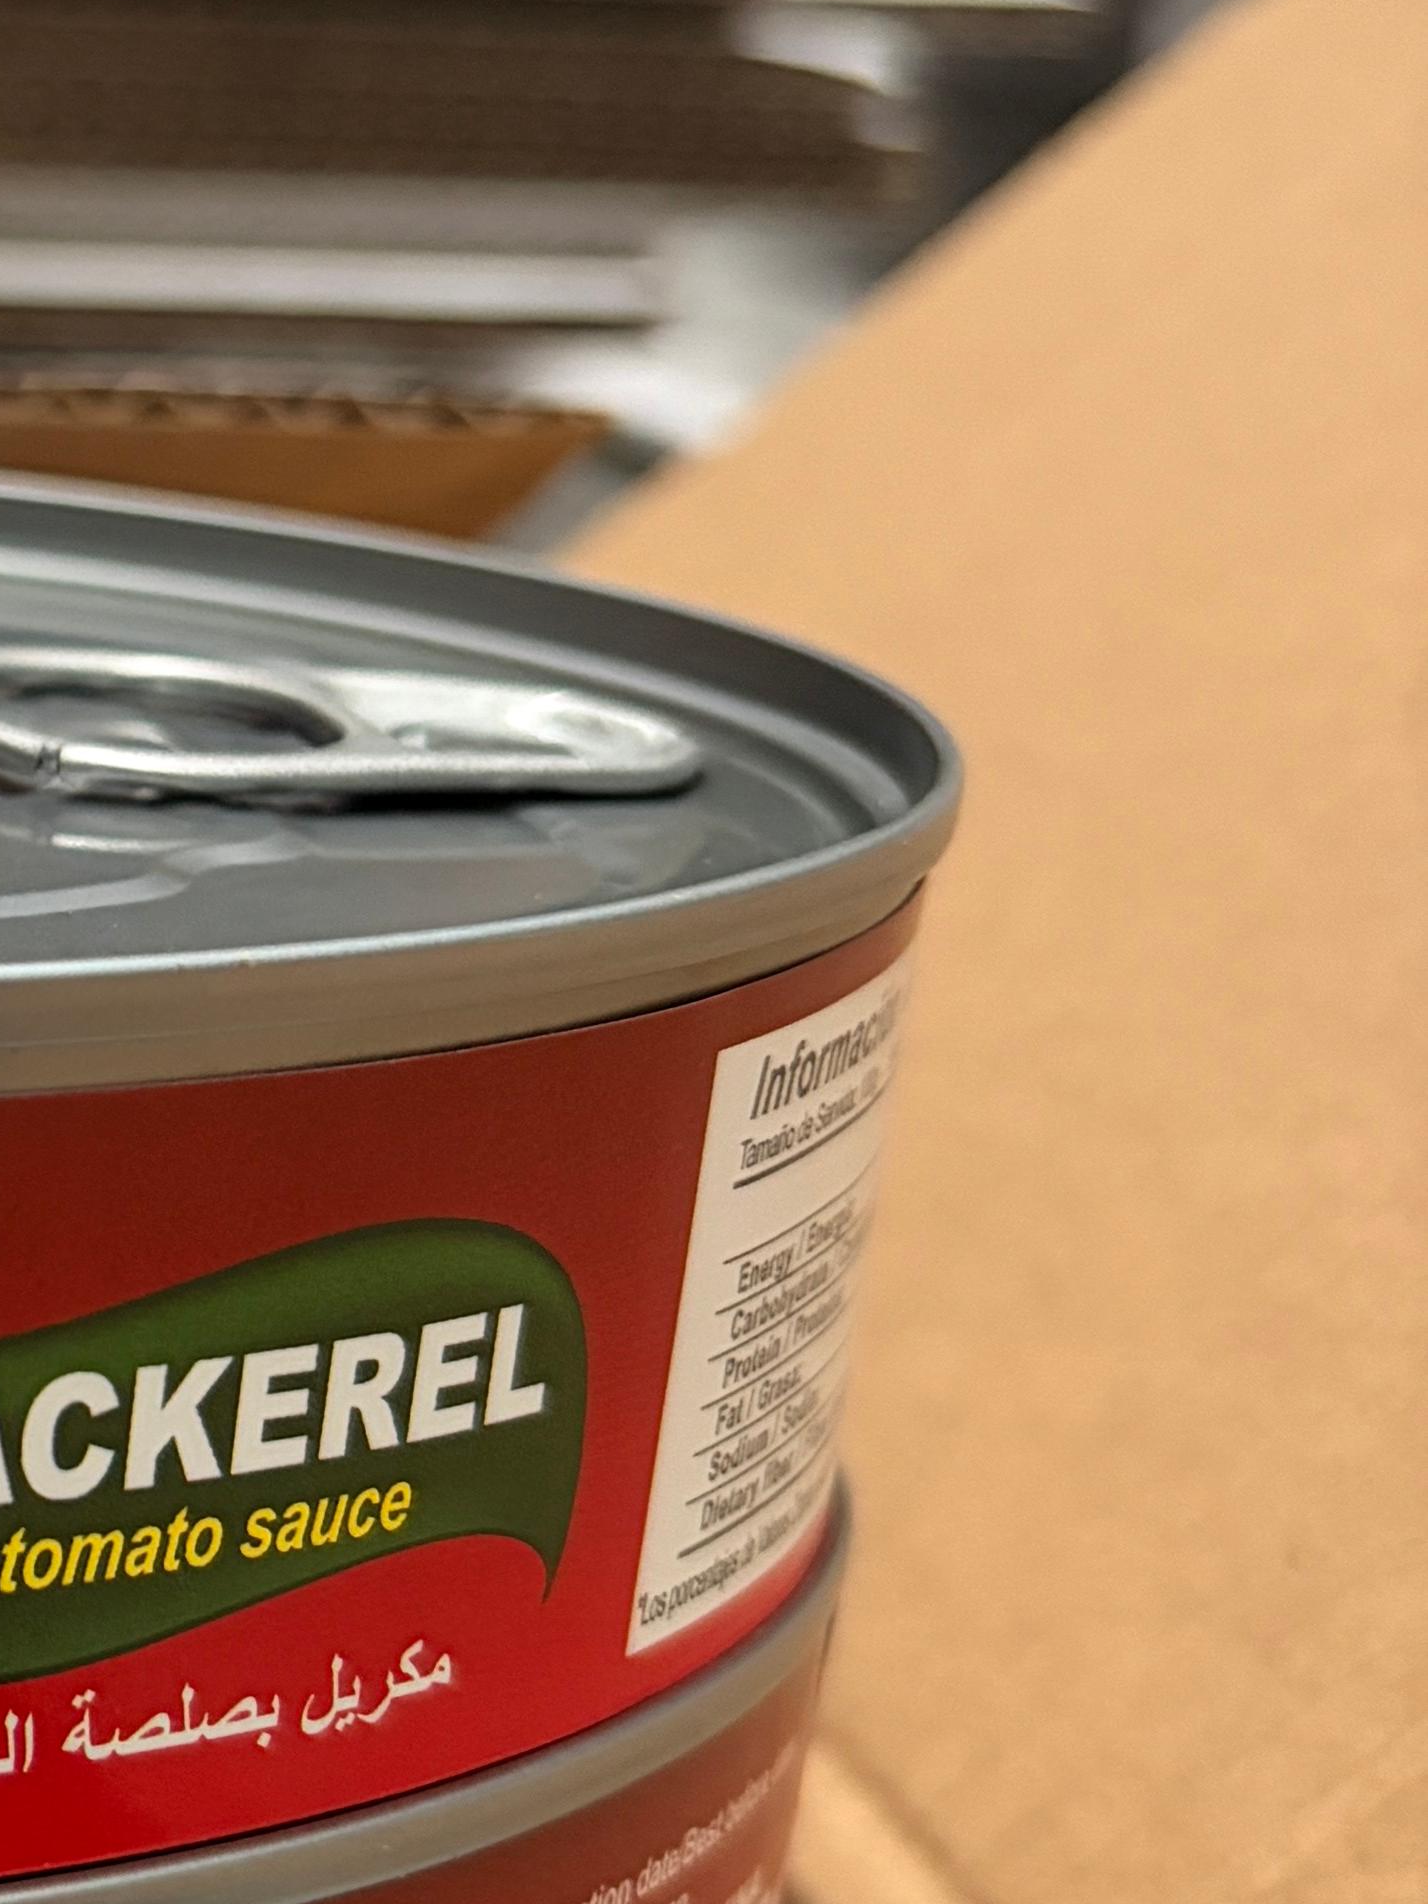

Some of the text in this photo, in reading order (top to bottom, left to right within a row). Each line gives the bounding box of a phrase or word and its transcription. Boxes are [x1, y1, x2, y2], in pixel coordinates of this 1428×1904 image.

[715, 1399, 744, 1436] Fat
[238, 1480, 414, 1563] sauce
[62, 1687, 282, 1760] بصلصة
[301, 1640, 453, 1738] مكريل
